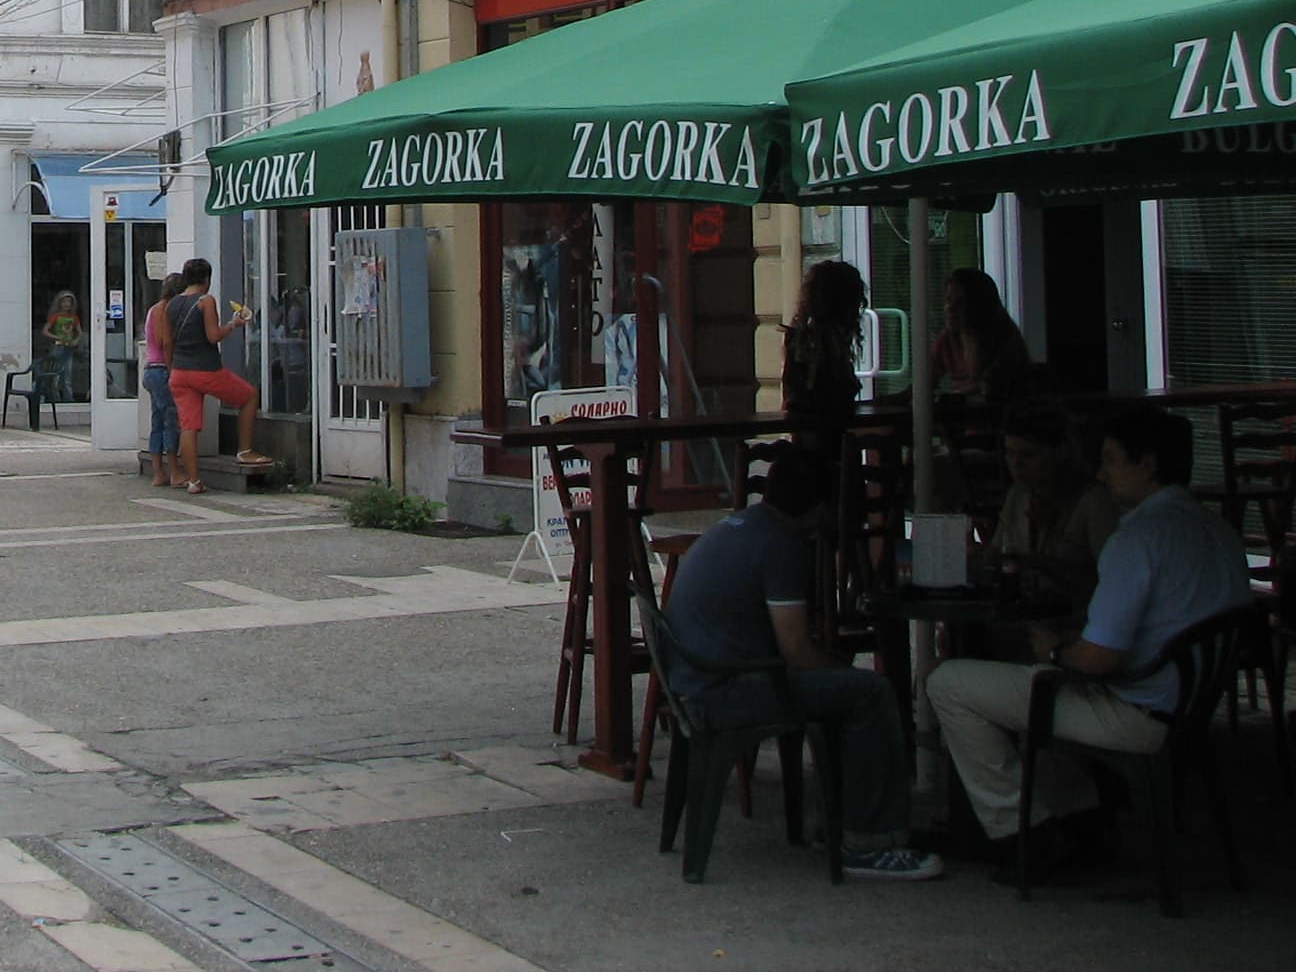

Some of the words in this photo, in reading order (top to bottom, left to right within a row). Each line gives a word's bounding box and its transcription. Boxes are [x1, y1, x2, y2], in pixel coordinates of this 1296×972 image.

[362, 126, 505, 189] ZAGORKA
[568, 120, 759, 189] ZAGORKA
[801, 68, 1051, 185] ZAGORKA
[212, 150, 316, 210] ZAGORKA
